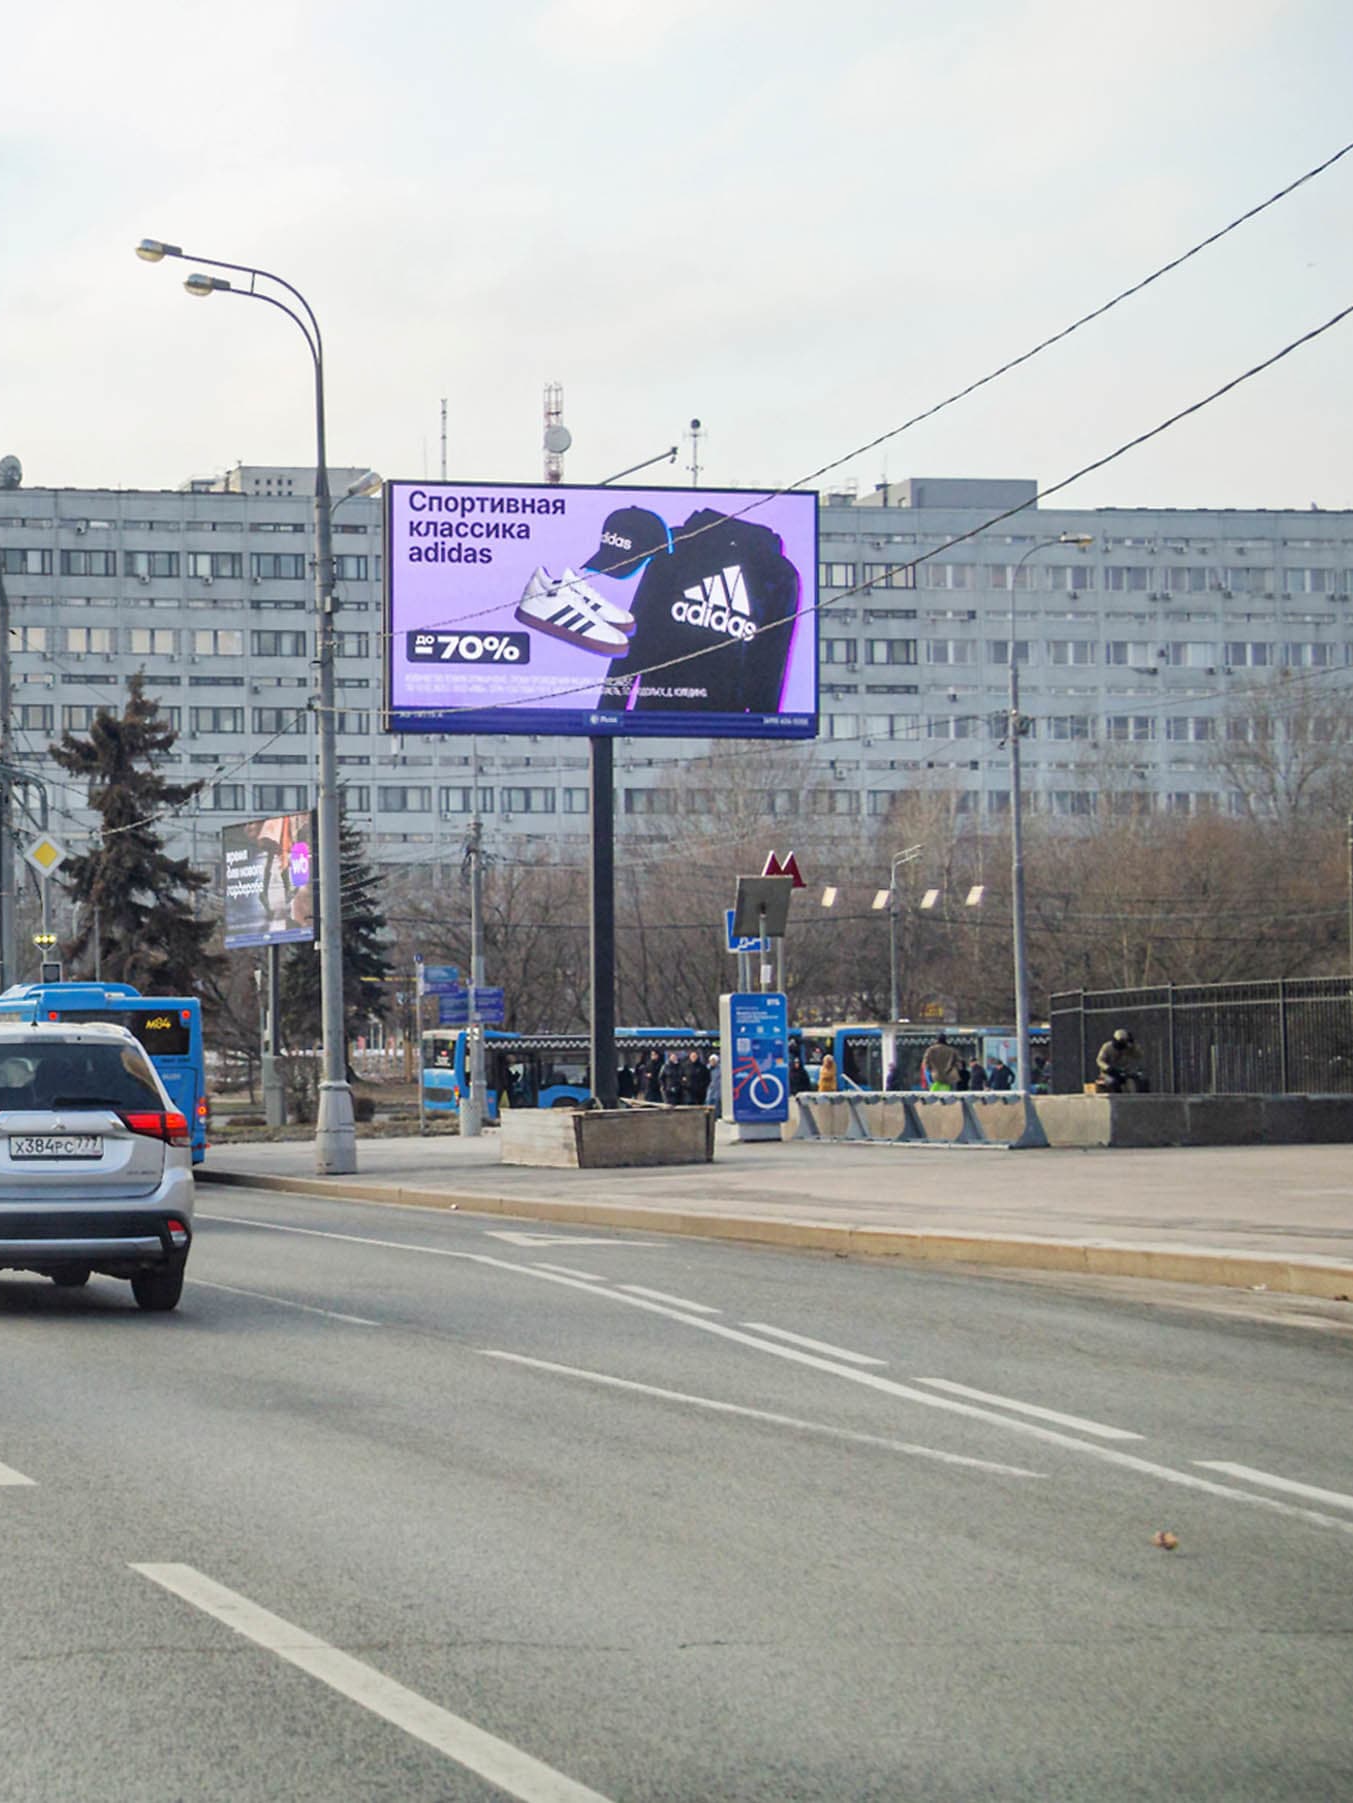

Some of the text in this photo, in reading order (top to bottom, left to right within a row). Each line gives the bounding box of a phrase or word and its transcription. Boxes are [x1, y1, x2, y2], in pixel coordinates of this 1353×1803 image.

[409, 490, 566, 518] Спортивная
[409, 520, 531, 540] классика
[409, 541, 493, 564] adidas
[671, 600, 757, 642] adidas
